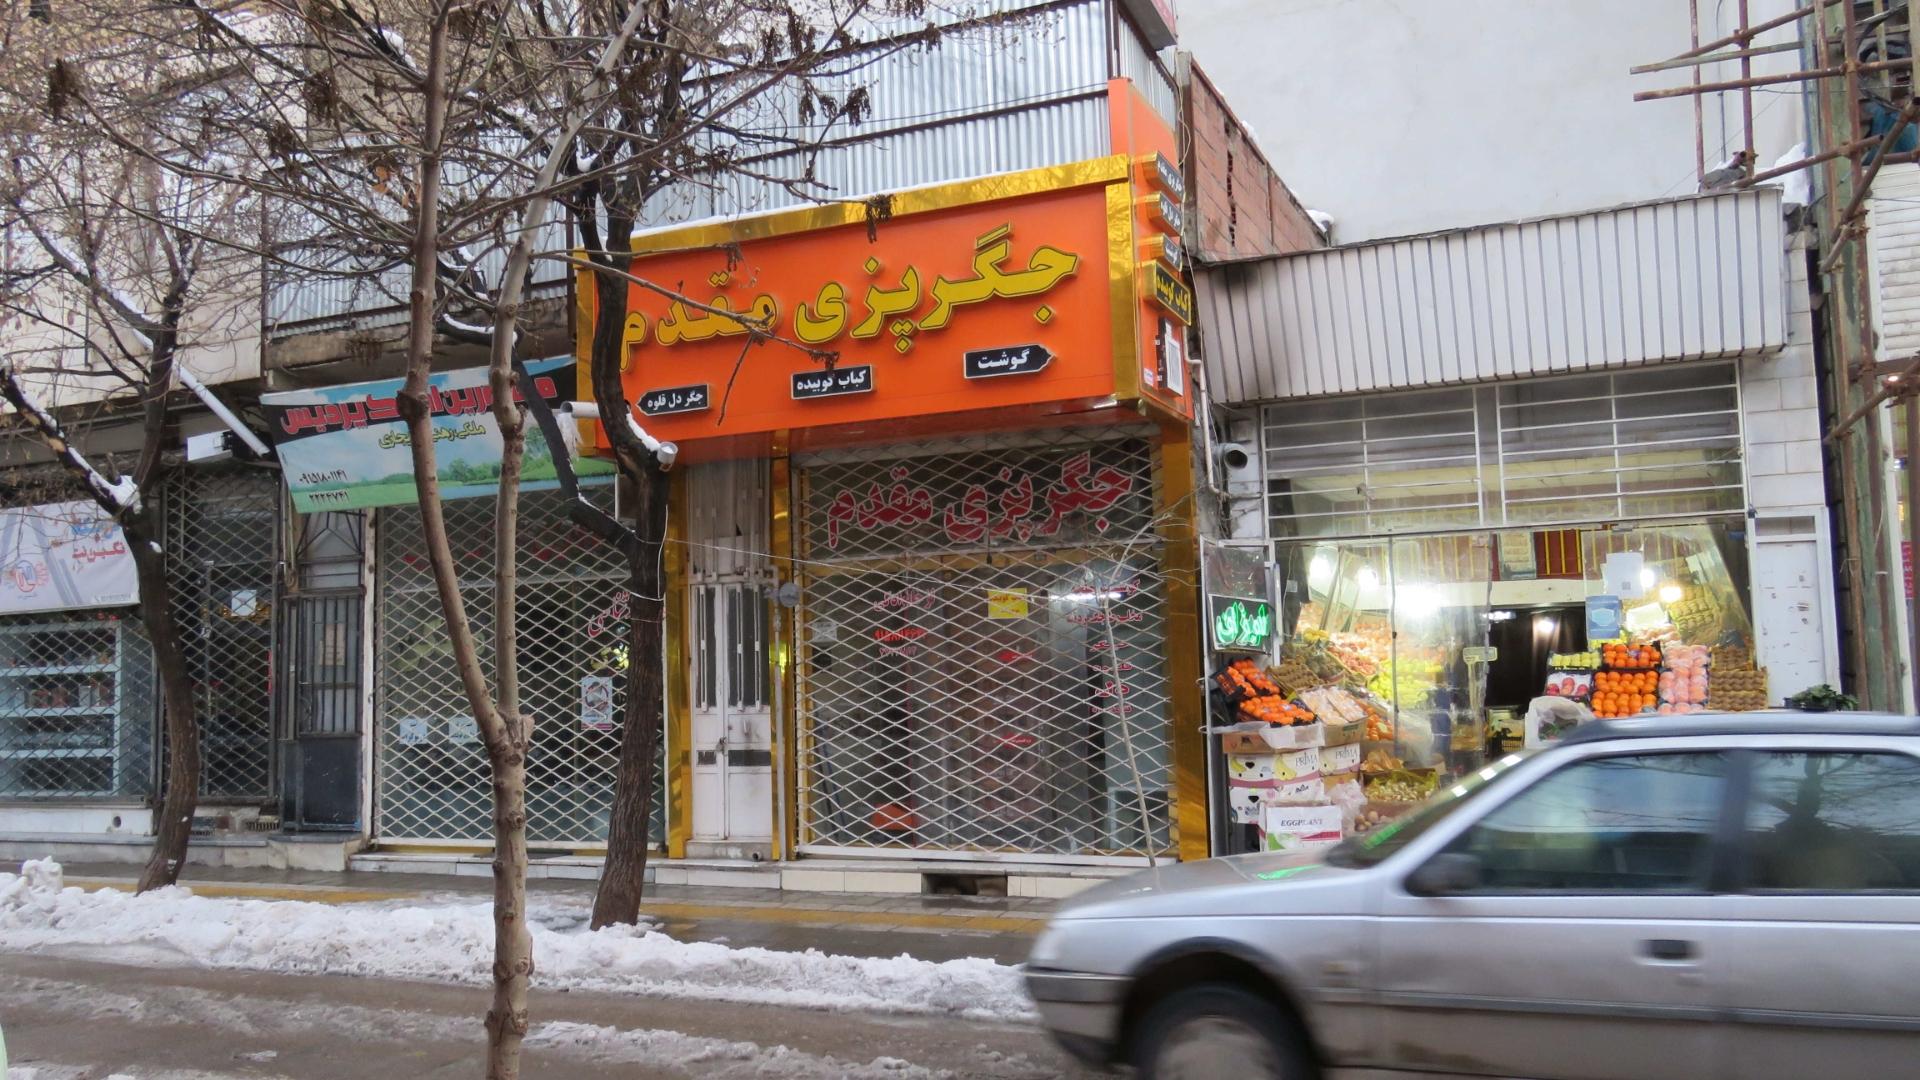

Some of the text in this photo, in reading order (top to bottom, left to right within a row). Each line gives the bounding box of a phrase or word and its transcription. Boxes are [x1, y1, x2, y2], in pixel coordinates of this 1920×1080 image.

[620, 270, 779, 373] مقدم
[977, 348, 1031, 371] گوشت
[838, 369, 867, 390] کباب
[647, 390, 704, 411] جگر دل قلوه
[827, 465, 934, 549] مقدم
[1295, 751, 1317, 768] PRIMA
[1335, 746, 1359, 760] PRIMA
